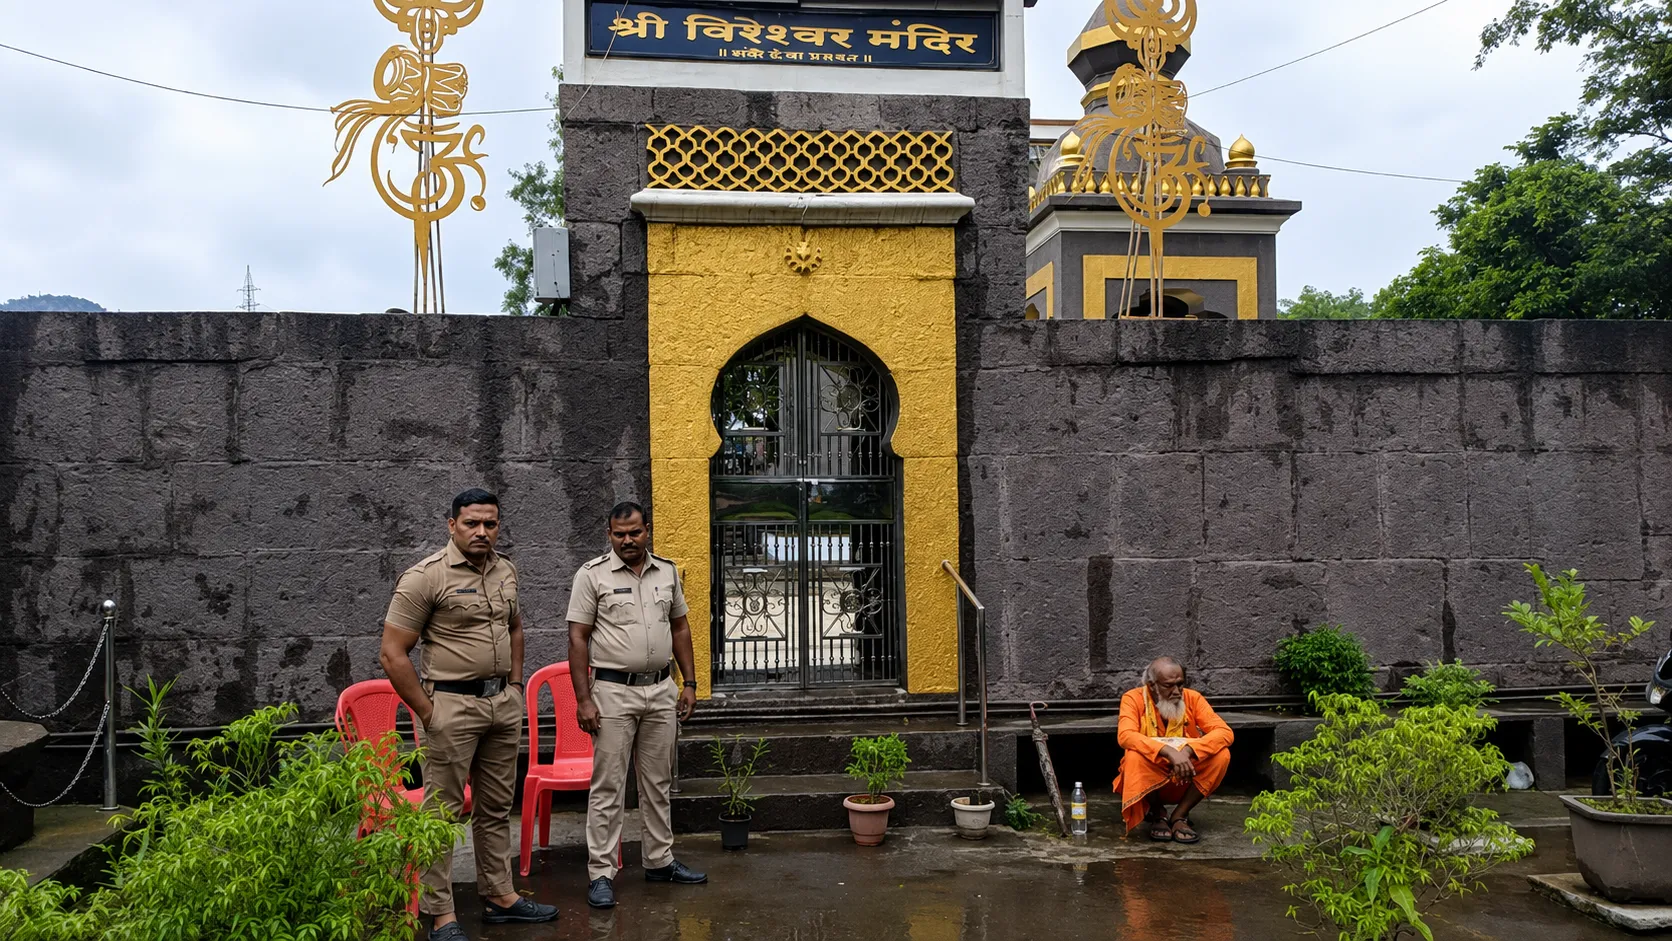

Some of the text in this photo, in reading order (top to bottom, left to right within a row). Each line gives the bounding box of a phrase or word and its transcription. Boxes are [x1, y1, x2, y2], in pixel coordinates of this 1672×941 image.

[608, 11, 978, 55] श्री विरेश्वर मंदिर
